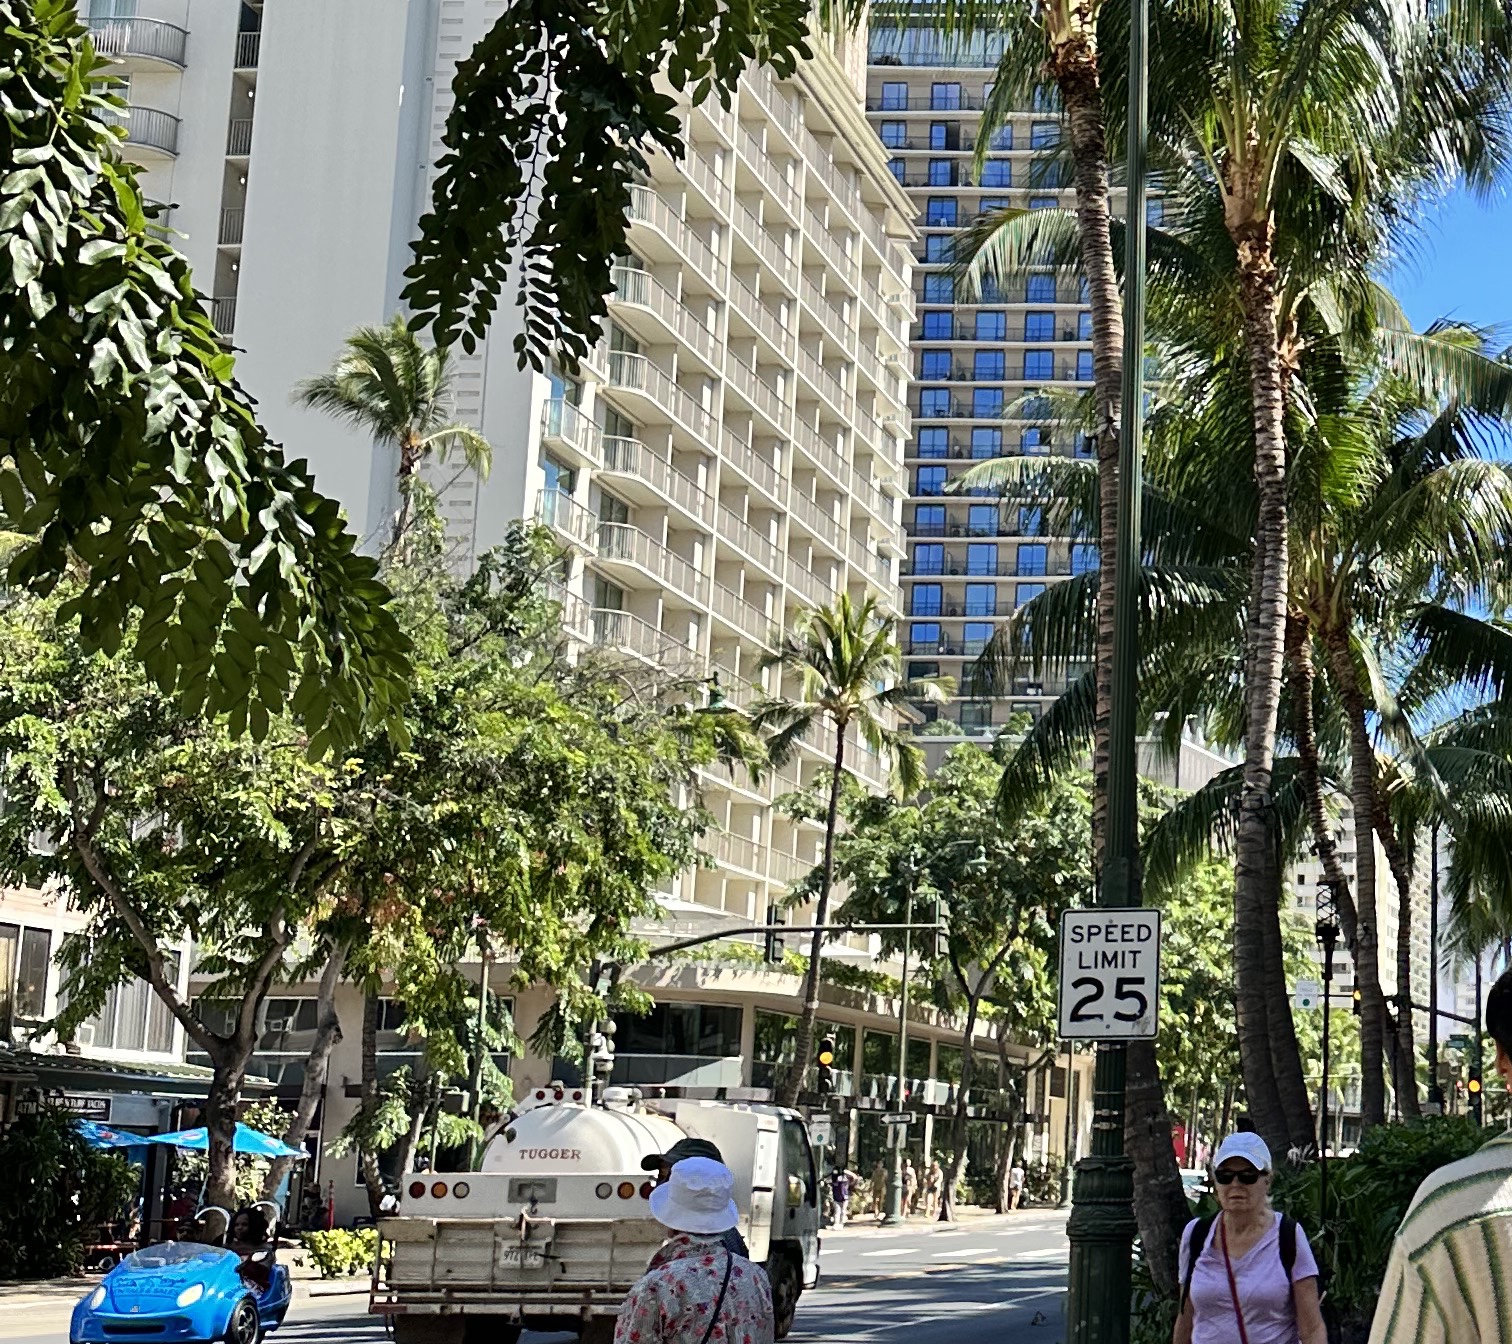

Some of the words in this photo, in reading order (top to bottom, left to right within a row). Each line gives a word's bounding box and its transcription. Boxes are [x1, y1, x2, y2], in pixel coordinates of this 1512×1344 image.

[1070, 924, 1152, 944] SPEED
[1079, 950, 1142, 970] LIMIT
[1069, 977, 1148, 1023] 25
[519, 1149, 582, 1160] TUGGER
